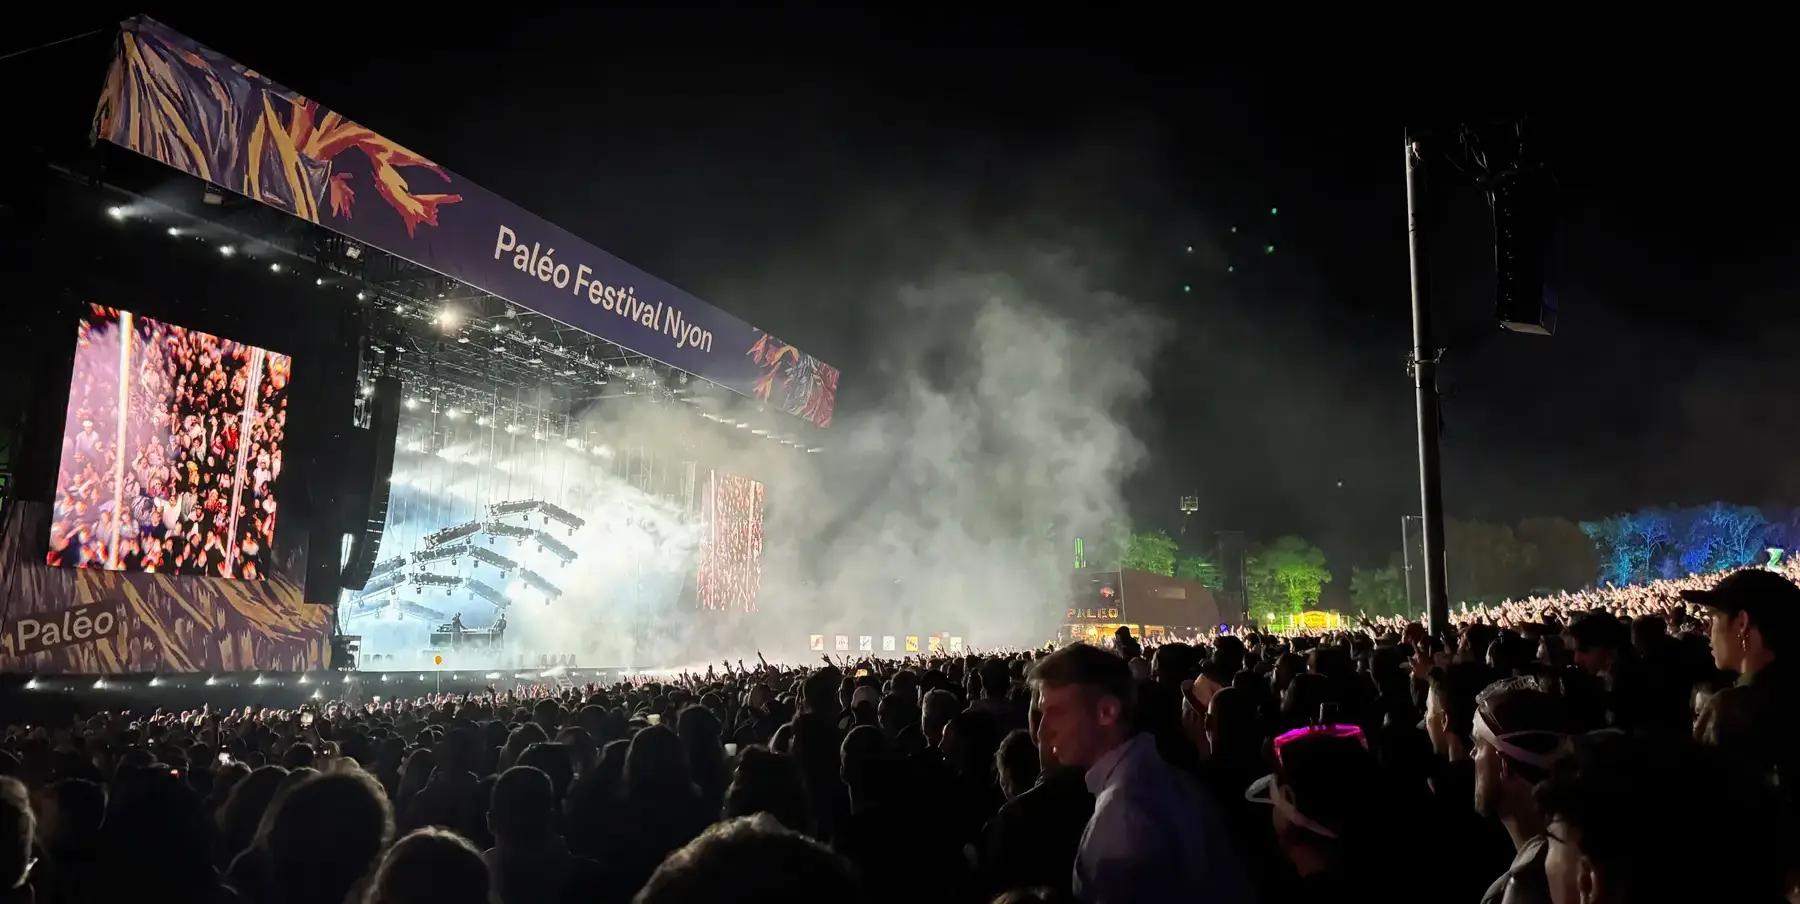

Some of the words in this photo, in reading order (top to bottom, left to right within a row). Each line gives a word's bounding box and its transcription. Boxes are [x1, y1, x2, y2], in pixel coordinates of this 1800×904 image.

[494, 224, 570, 289] Paléo
[573, 263, 663, 331] Festival
[663, 305, 713, 353] Nyon
[17, 608, 114, 651] Paléo
